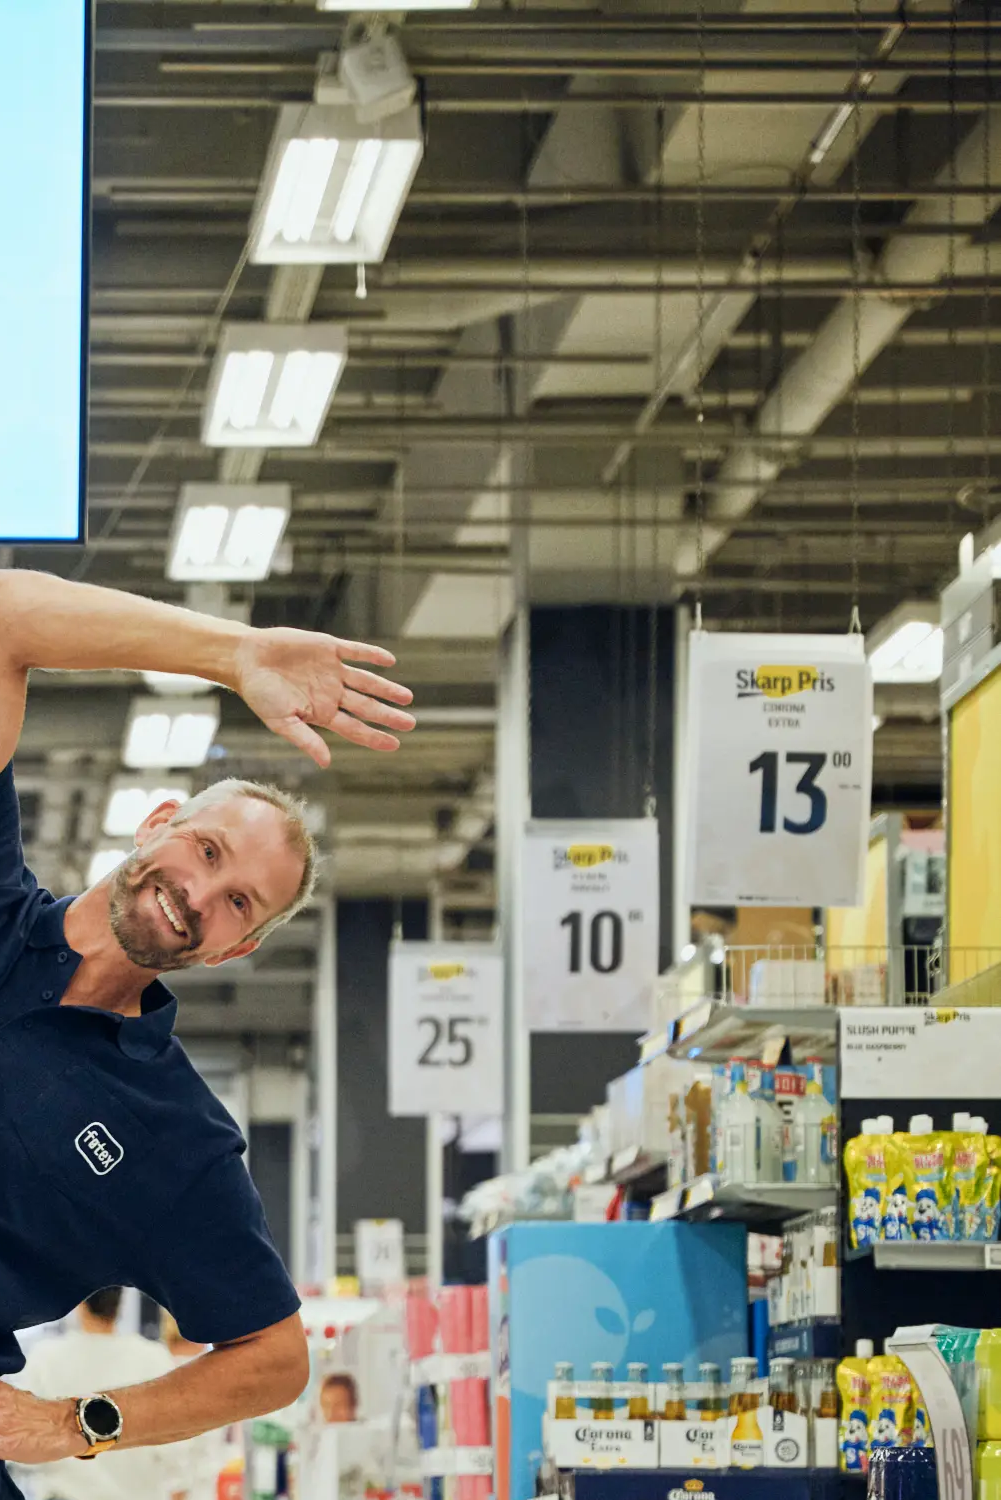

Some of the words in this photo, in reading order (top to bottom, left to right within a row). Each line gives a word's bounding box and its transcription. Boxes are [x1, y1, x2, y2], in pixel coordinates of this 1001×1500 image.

[736, 669, 792, 695] Skarp
[799, 671, 835, 693] Pris
[762, 702, 806, 714] CORONA
[768, 717, 801, 729] EXTRA
[749, 751, 827, 835] 13
[833, 752, 852, 768] 00
[560, 909, 624, 975] 10
[924, 1011, 951, 1025] Skarp
[953, 1010, 971, 1022] Pris
[417, 1016, 474, 1068] 25
[83, 1130, 115, 1168] føtex
[575, 1424, 633, 1446] Corona
[685, 1425, 714, 1446] Cor
